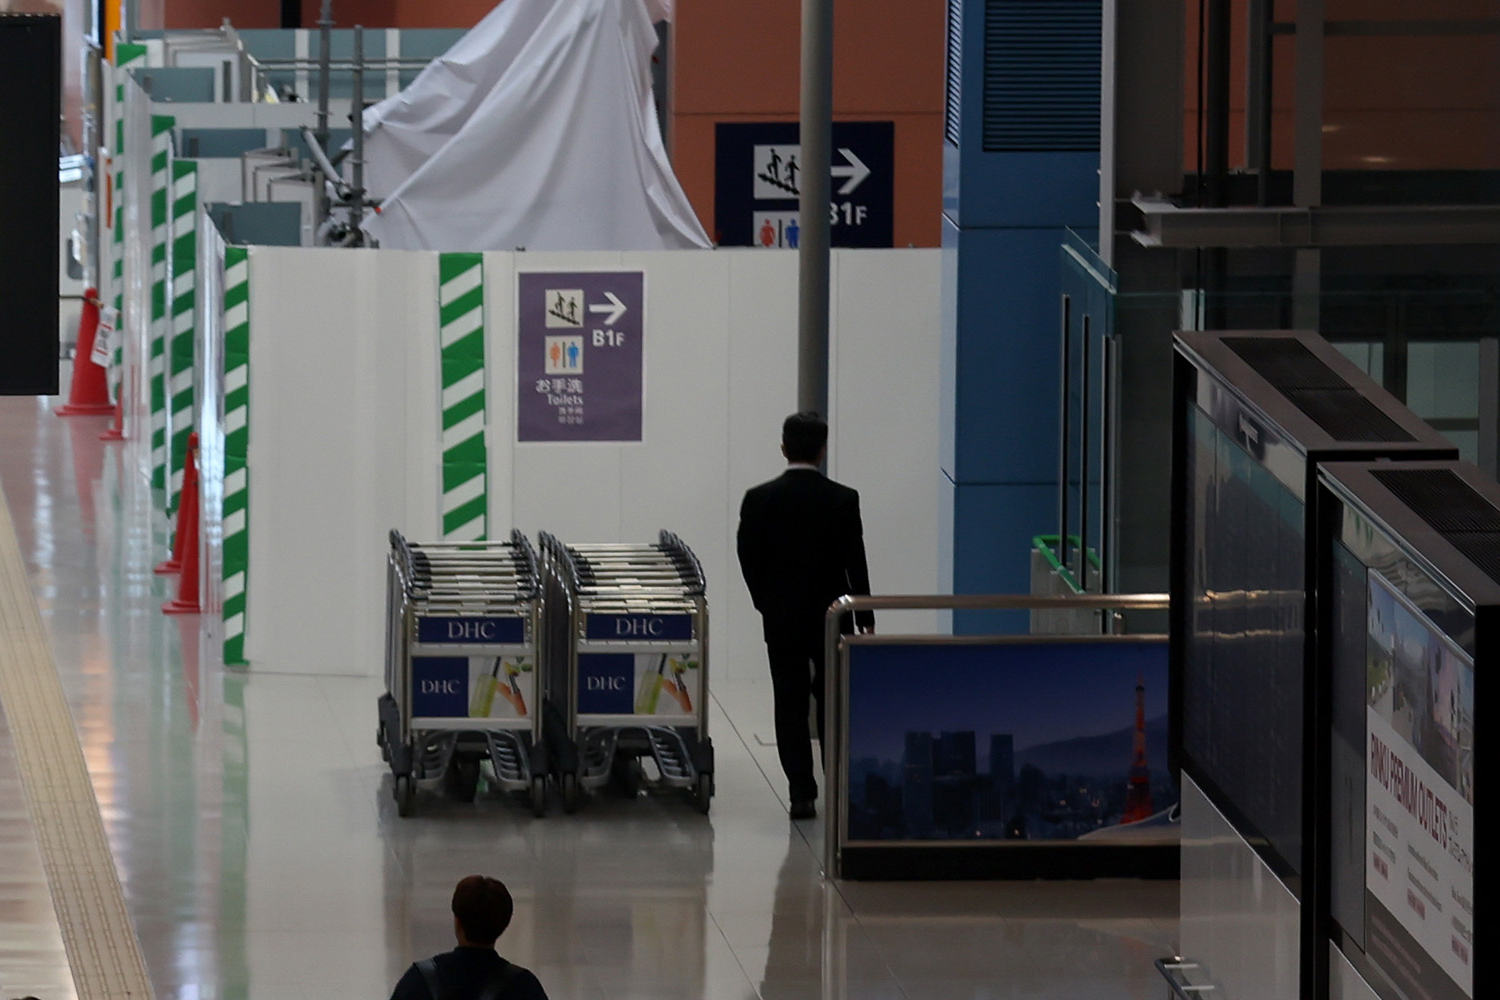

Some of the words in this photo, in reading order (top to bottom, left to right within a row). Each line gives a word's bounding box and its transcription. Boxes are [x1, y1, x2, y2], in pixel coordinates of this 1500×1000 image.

[592, 329, 625, 347] B1F
[548, 394, 583, 405] Toilets
[448, 622, 496, 639] DHC
[616, 618, 664, 635] DHC
[421, 680, 461, 694] DHC
[587, 676, 626, 690] DHC
[1371, 732, 1389, 793] RINKU
[1390, 750, 1418, 819] PREMIUM
[1419, 780, 1447, 850] OUTLETS
